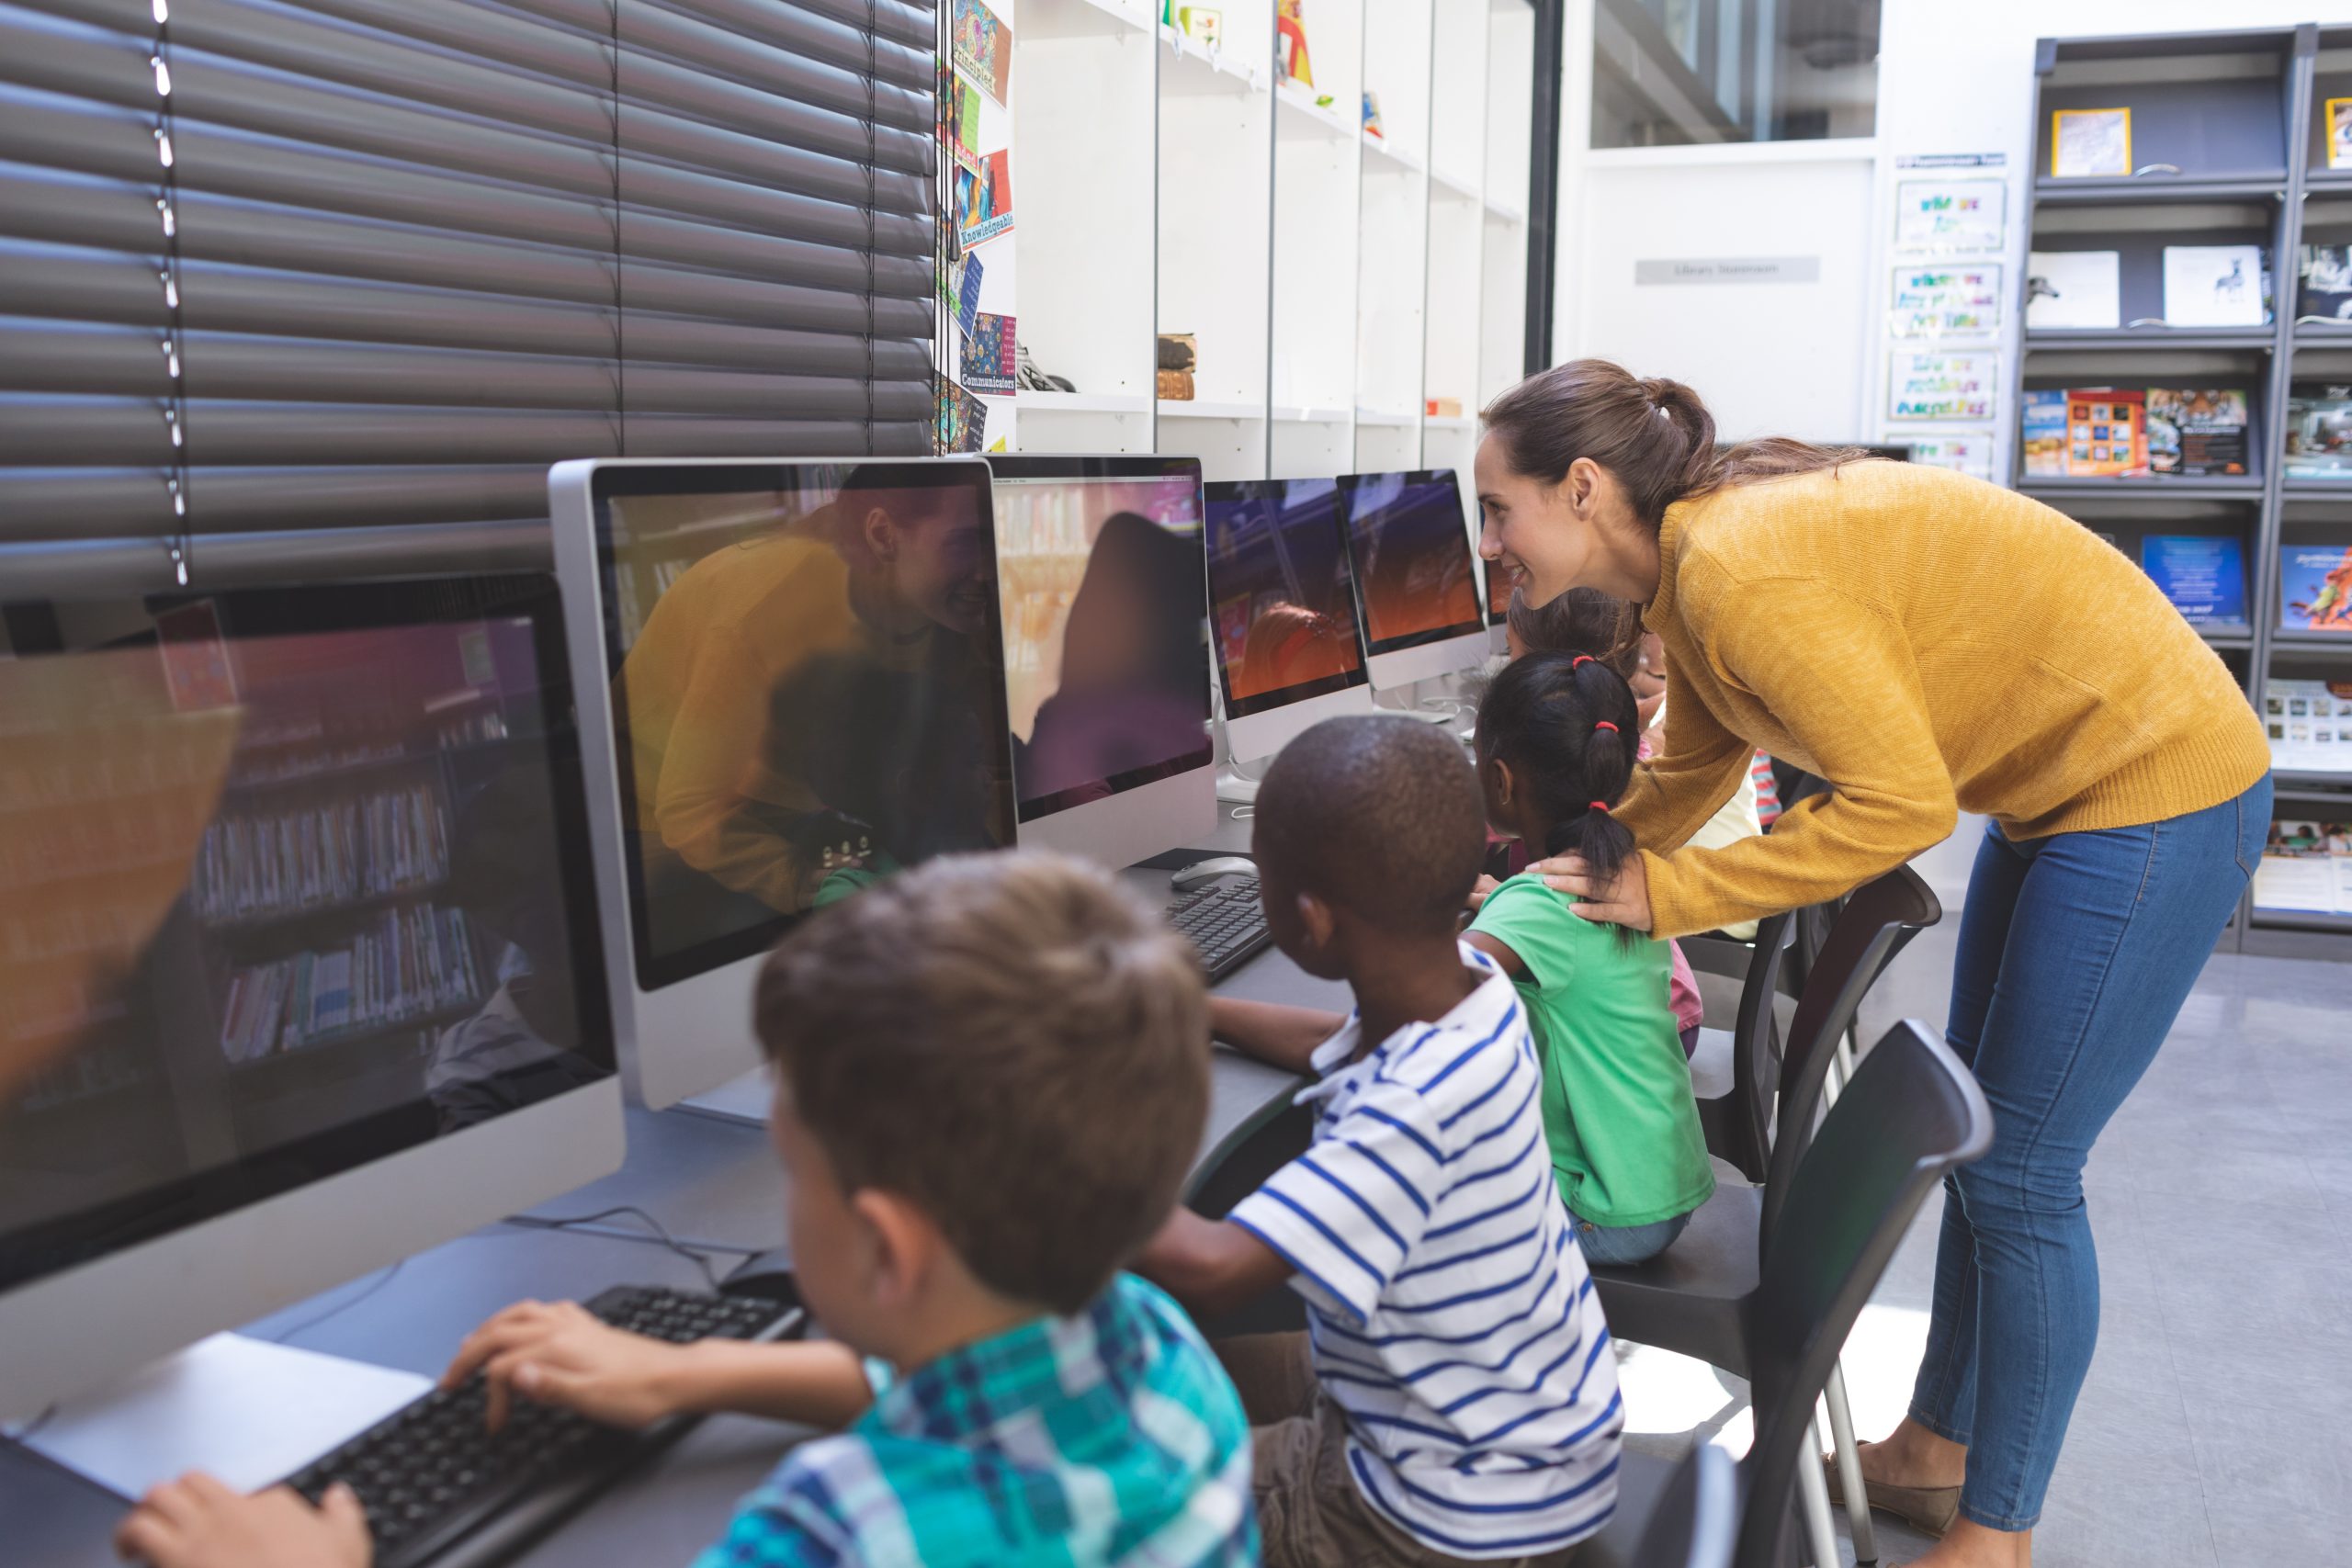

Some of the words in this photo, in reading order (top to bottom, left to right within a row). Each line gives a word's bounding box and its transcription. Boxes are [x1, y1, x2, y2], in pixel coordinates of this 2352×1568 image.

[953, 43, 993, 89] Principled
[961, 213, 1013, 244] Knowledgeable
[962, 374, 1014, 389] Communicators
